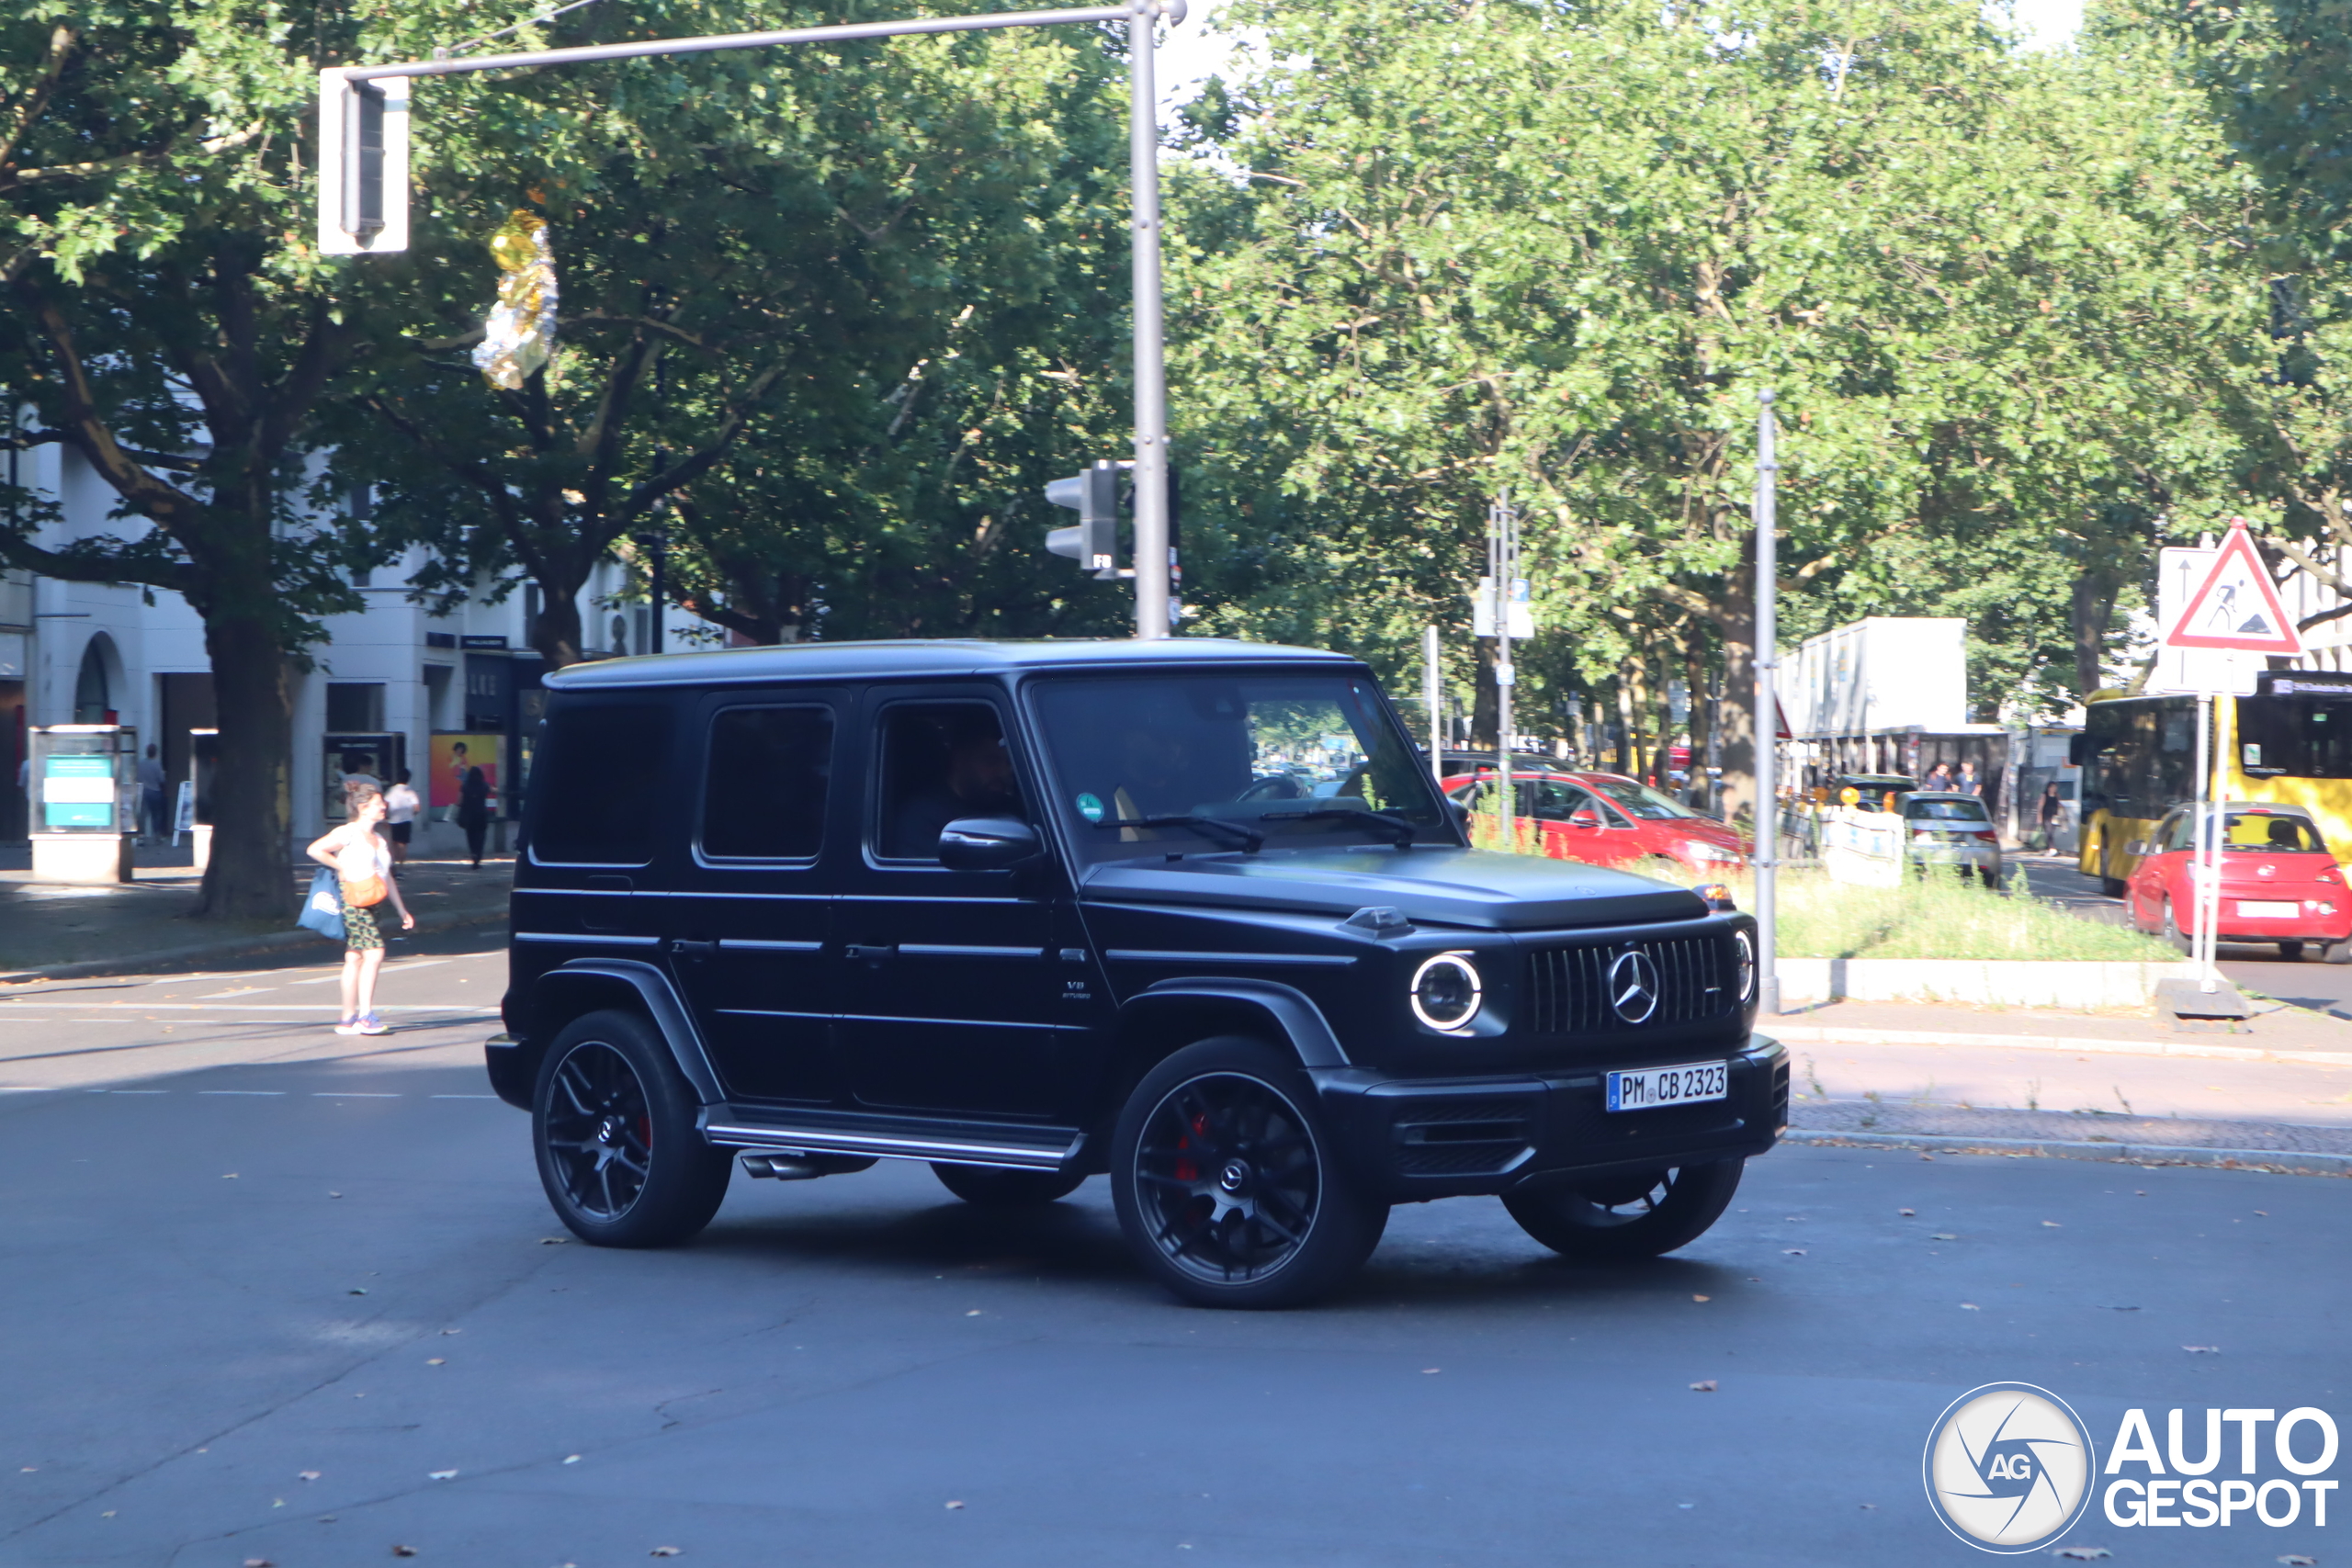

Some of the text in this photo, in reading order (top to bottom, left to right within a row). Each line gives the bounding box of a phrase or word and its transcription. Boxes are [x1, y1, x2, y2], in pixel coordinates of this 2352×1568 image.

[1623, 1066, 1725, 1104] PM CB 2323
